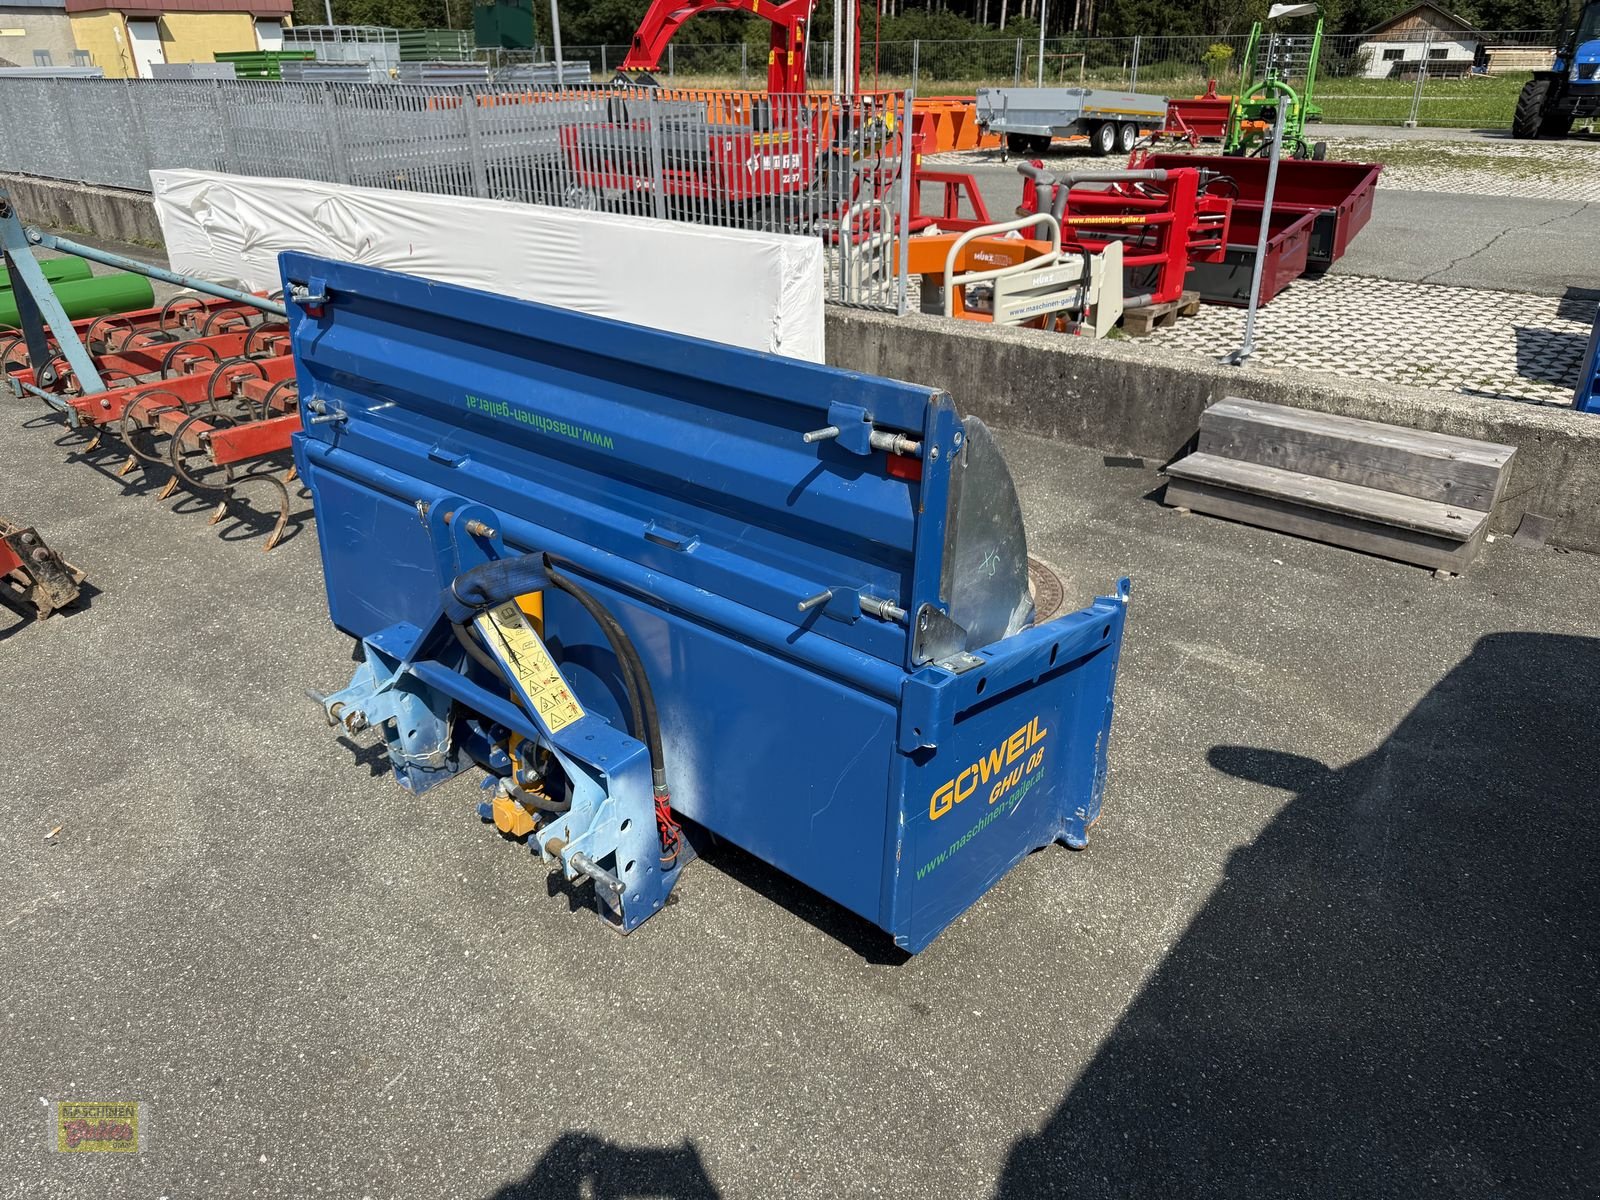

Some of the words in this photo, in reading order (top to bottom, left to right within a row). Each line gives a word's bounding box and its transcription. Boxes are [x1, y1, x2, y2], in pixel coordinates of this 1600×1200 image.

[1068, 216, 1146, 225] www.maschinen-gailer.at
[465, 394, 615, 450] www.maschinen-gailer.at
[989, 763, 1024, 805] GHU
[1026, 746, 1045, 773] 08
[916, 766, 1046, 881] www.maschinen-gailer.at
